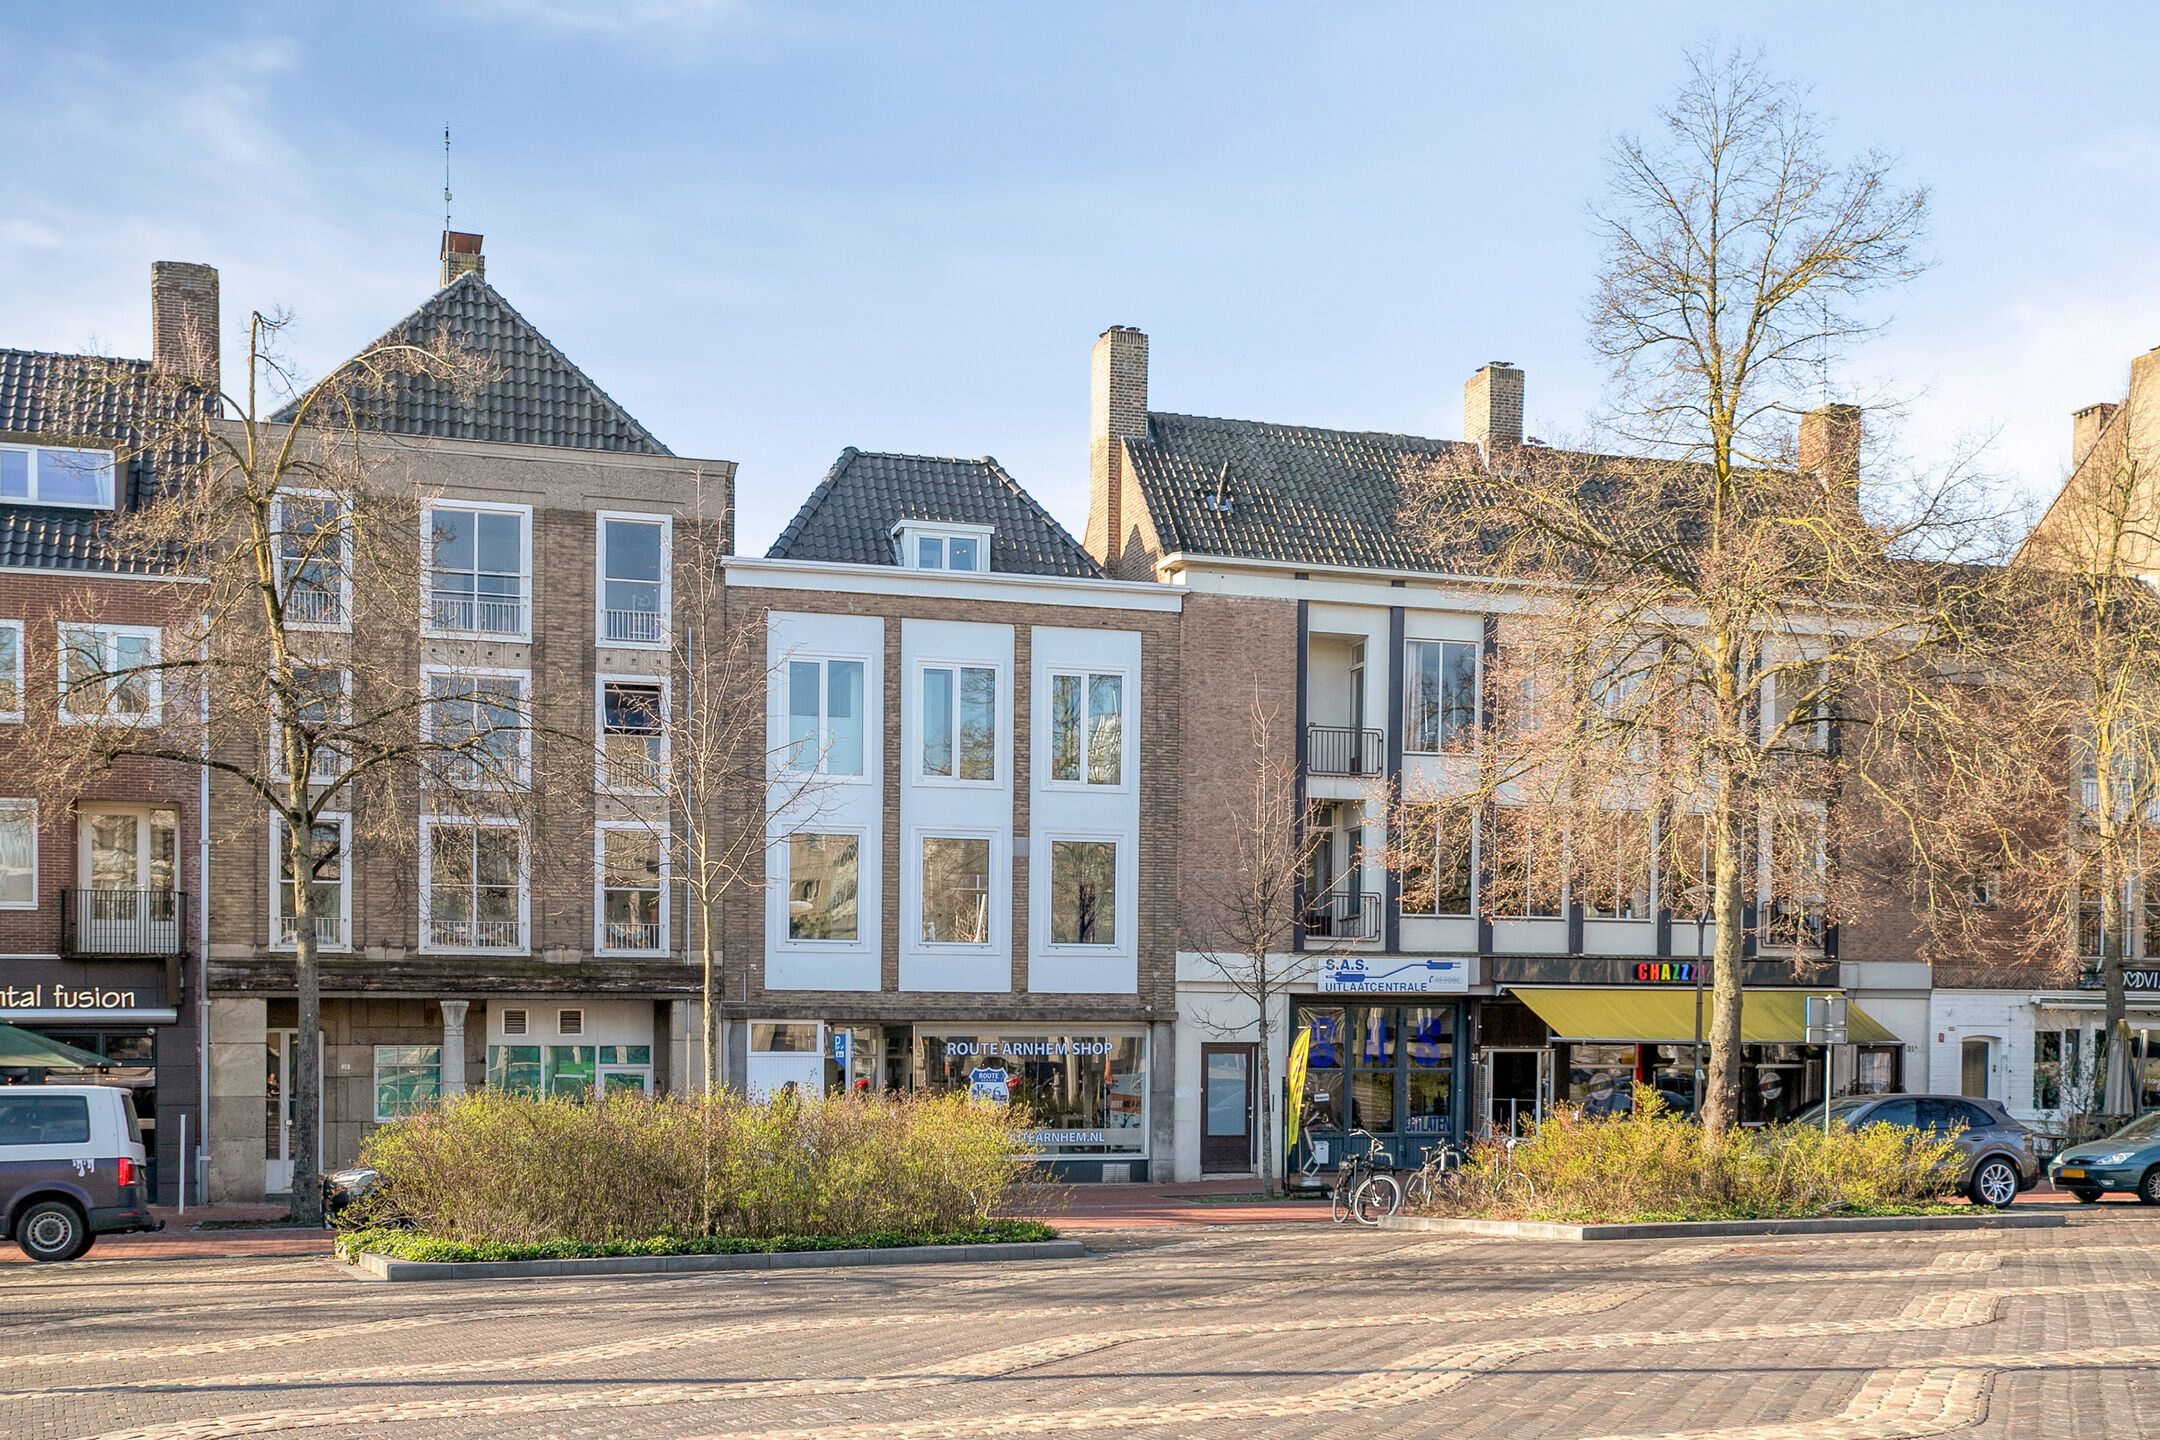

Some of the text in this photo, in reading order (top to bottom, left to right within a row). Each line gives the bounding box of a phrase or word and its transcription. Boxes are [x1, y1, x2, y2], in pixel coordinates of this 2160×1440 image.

[1325, 958, 1369, 971] S.A.S.
[1325, 982, 1428, 992] UITLAATCENTRALE
[53, 984, 135, 1008] fusion
[946, 1042, 1113, 1056] ROUTE ARNHEM SHOP
